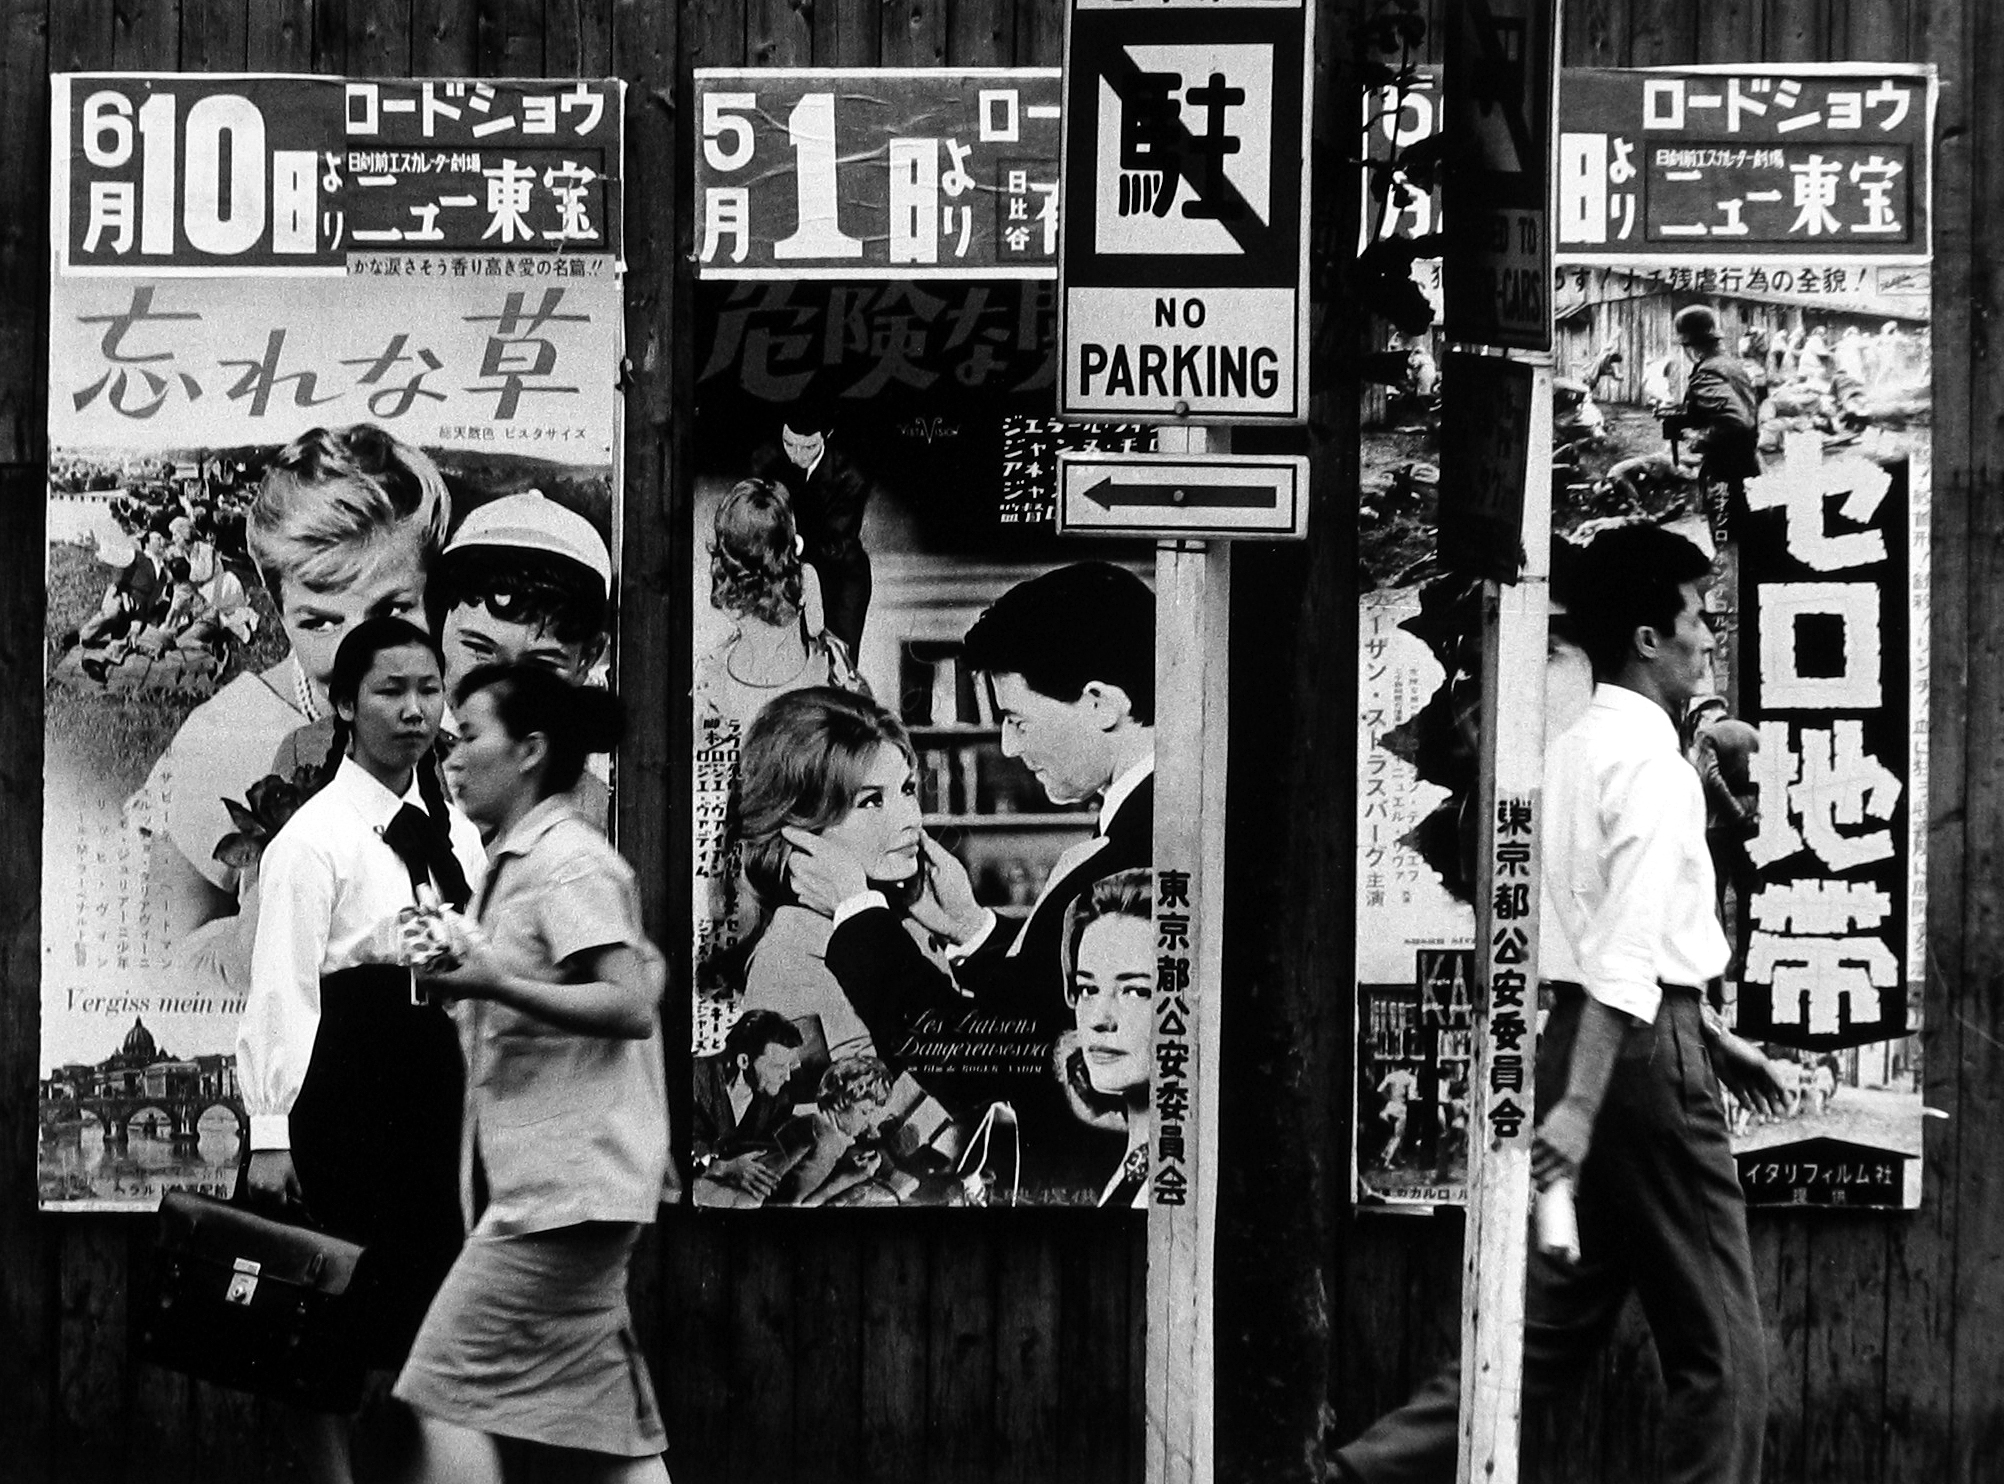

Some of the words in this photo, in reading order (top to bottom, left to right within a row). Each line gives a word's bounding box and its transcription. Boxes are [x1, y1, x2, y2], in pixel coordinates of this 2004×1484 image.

[346, 82, 604, 138] ロードショウ
[1643, 78, 1911, 133] ロードショウ
[352, 158, 600, 243] ニュー東宝
[942, 139, 976, 258] より
[1609, 138, 1637, 240] より
[1659, 154, 1904, 236] ニュー東宝
[73, 286, 590, 420] 忘れな草
[1155, 297, 1206, 328] NO
[1080, 343, 1278, 399] PARKING
[66, 988, 150, 1016] Vergiss
[158, 990, 213, 1014] mein
[1488, 798, 1532, 1138] 東京都公安委員会
[1154, 869, 1191, 1206] 東京都公安委員会
